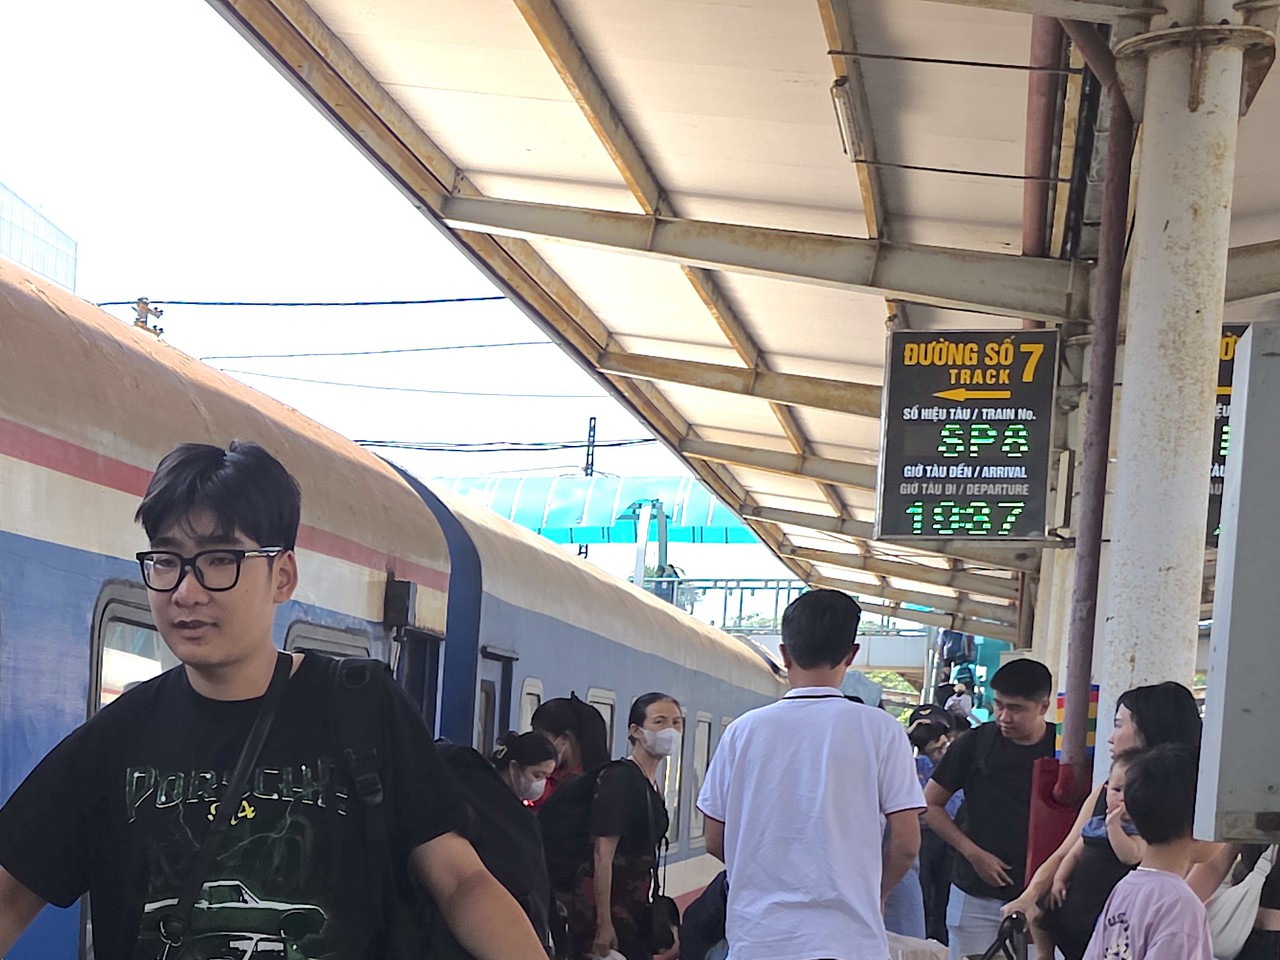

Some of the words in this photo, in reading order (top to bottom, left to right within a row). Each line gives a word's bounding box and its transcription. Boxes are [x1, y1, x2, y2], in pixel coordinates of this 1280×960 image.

[903, 337, 979, 366] ĐƯỜNG
[984, 335, 1016, 366] SỐ
[1020, 343, 1045, 383] 7
[949, 368, 1011, 385] TRACK
[902, 403, 920, 420] SỐ
[921, 406, 947, 422] HIỆU
[949, 406, 971, 420] TÀU
[981, 408, 1015, 420] TRAIN
[1017, 408, 1037, 420] No.
[925, 463, 947, 478] TÀU
[981, 466, 1028, 478] ARRIVAL
[966, 483, 1030, 496] DEPARTURE
